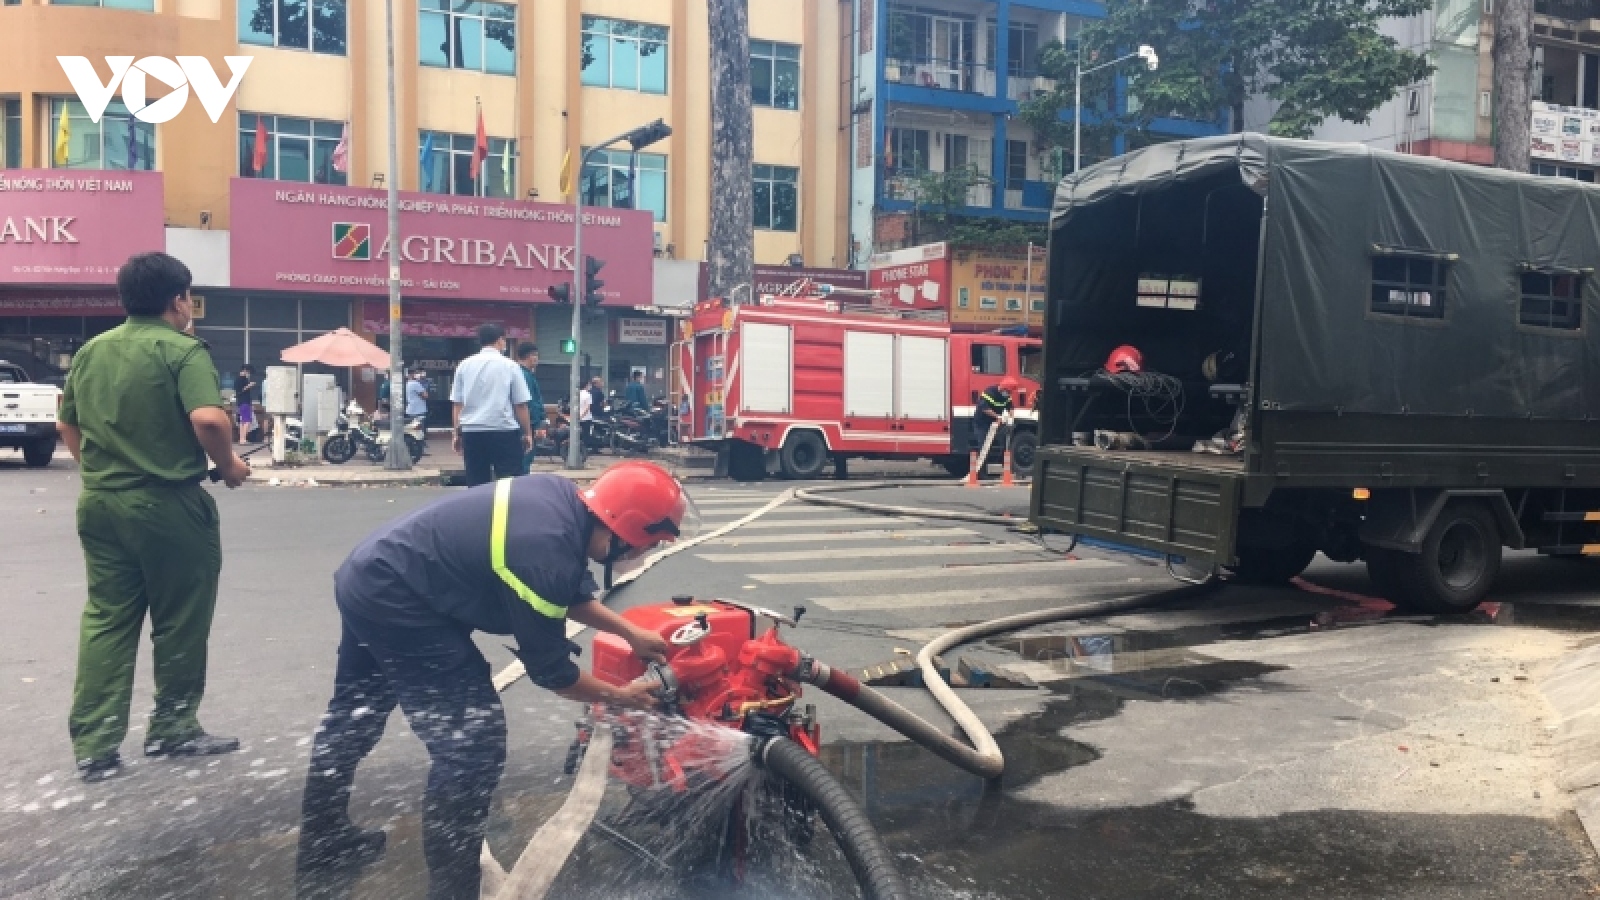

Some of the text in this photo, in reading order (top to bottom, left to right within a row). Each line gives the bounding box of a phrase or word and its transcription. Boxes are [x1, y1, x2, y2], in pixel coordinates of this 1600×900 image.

[12, 176, 42, 192] NÔNG
[46, 176, 74, 191] THÔN
[77, 176, 101, 195] VIỆT
[104, 179, 133, 191] NAM
[275, 189, 315, 203] NGÂN
[319, 193, 357, 207] HÀNG
[451, 202, 480, 217] PHÁT
[483, 202, 513, 219] TRIỂN
[514, 207, 545, 221] NÔNG
[597, 215, 621, 227] NAM
[0, 216, 80, 244] ANK
[375, 234, 577, 272] AGRIBANK
[881, 267, 907, 283] PHONE
